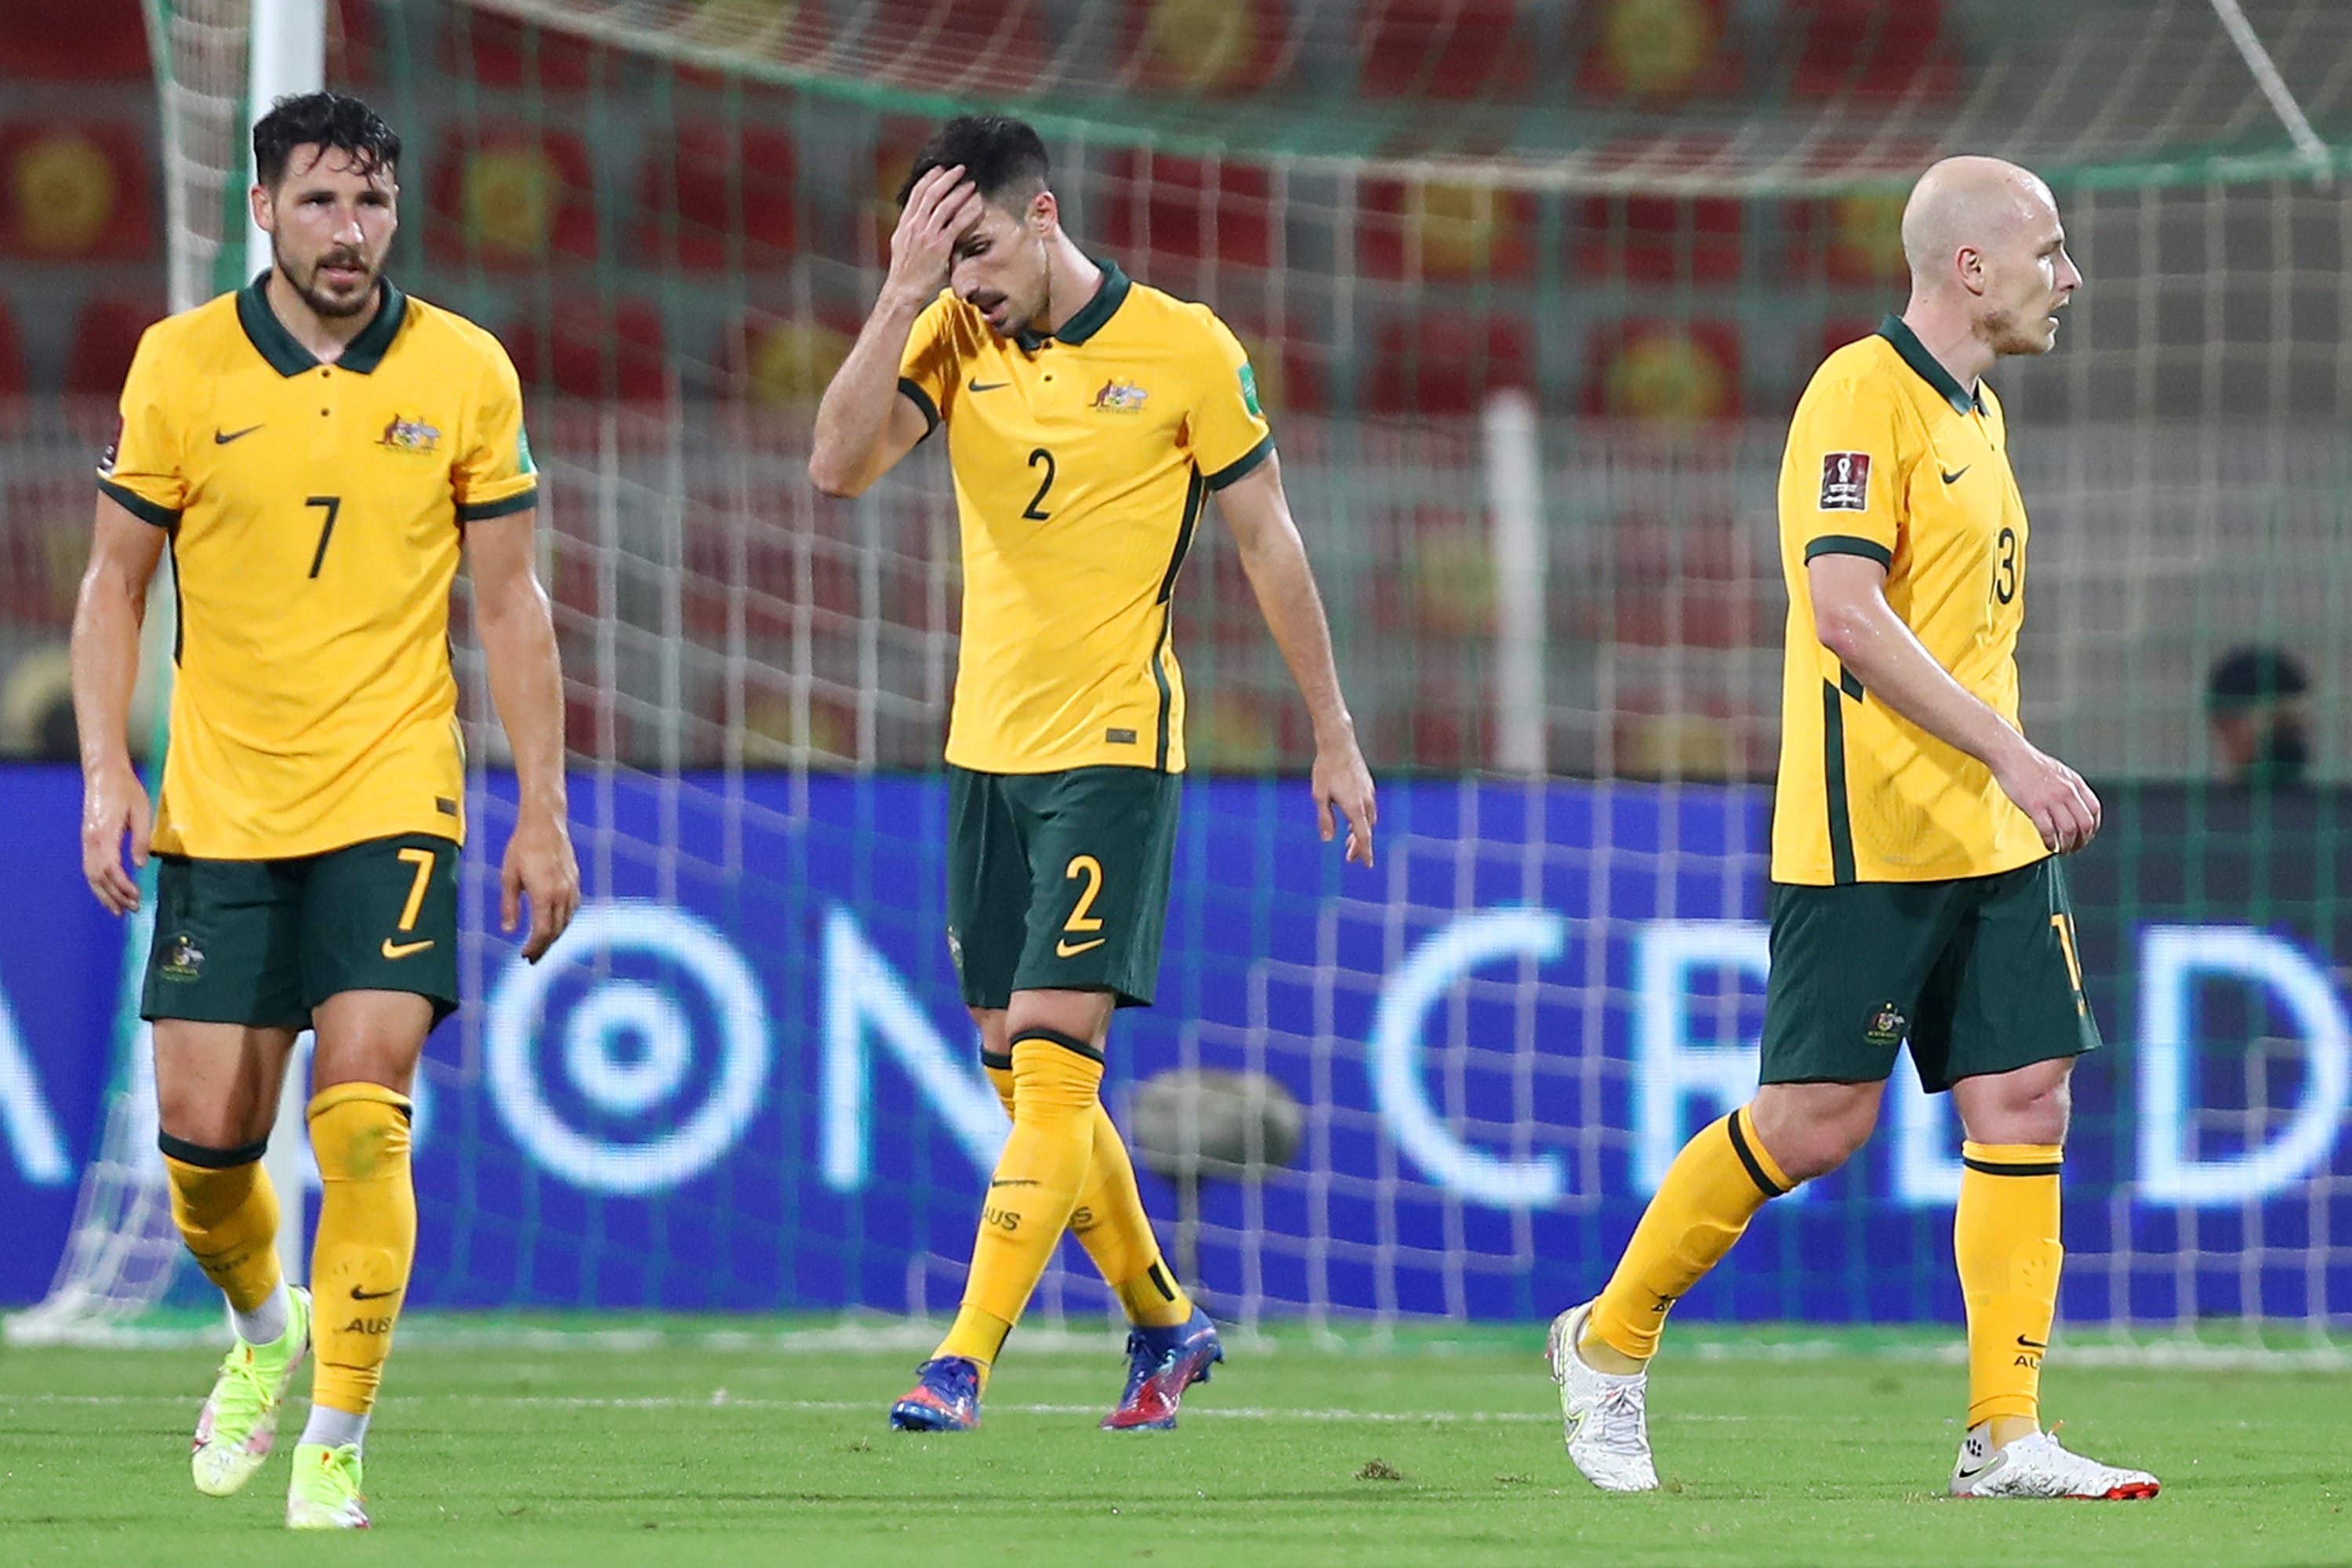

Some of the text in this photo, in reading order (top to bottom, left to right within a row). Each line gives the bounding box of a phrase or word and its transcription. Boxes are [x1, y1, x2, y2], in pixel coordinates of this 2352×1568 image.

[1022, 448, 1055, 521] 2
[305, 496, 341, 579] 7
[1990, 527, 2016, 605] 3
[397, 848, 435, 931] 7
[1064, 855, 1104, 931] 2
[2050, 912, 2082, 992] 1
[344, 1317, 393, 1335] AUS
